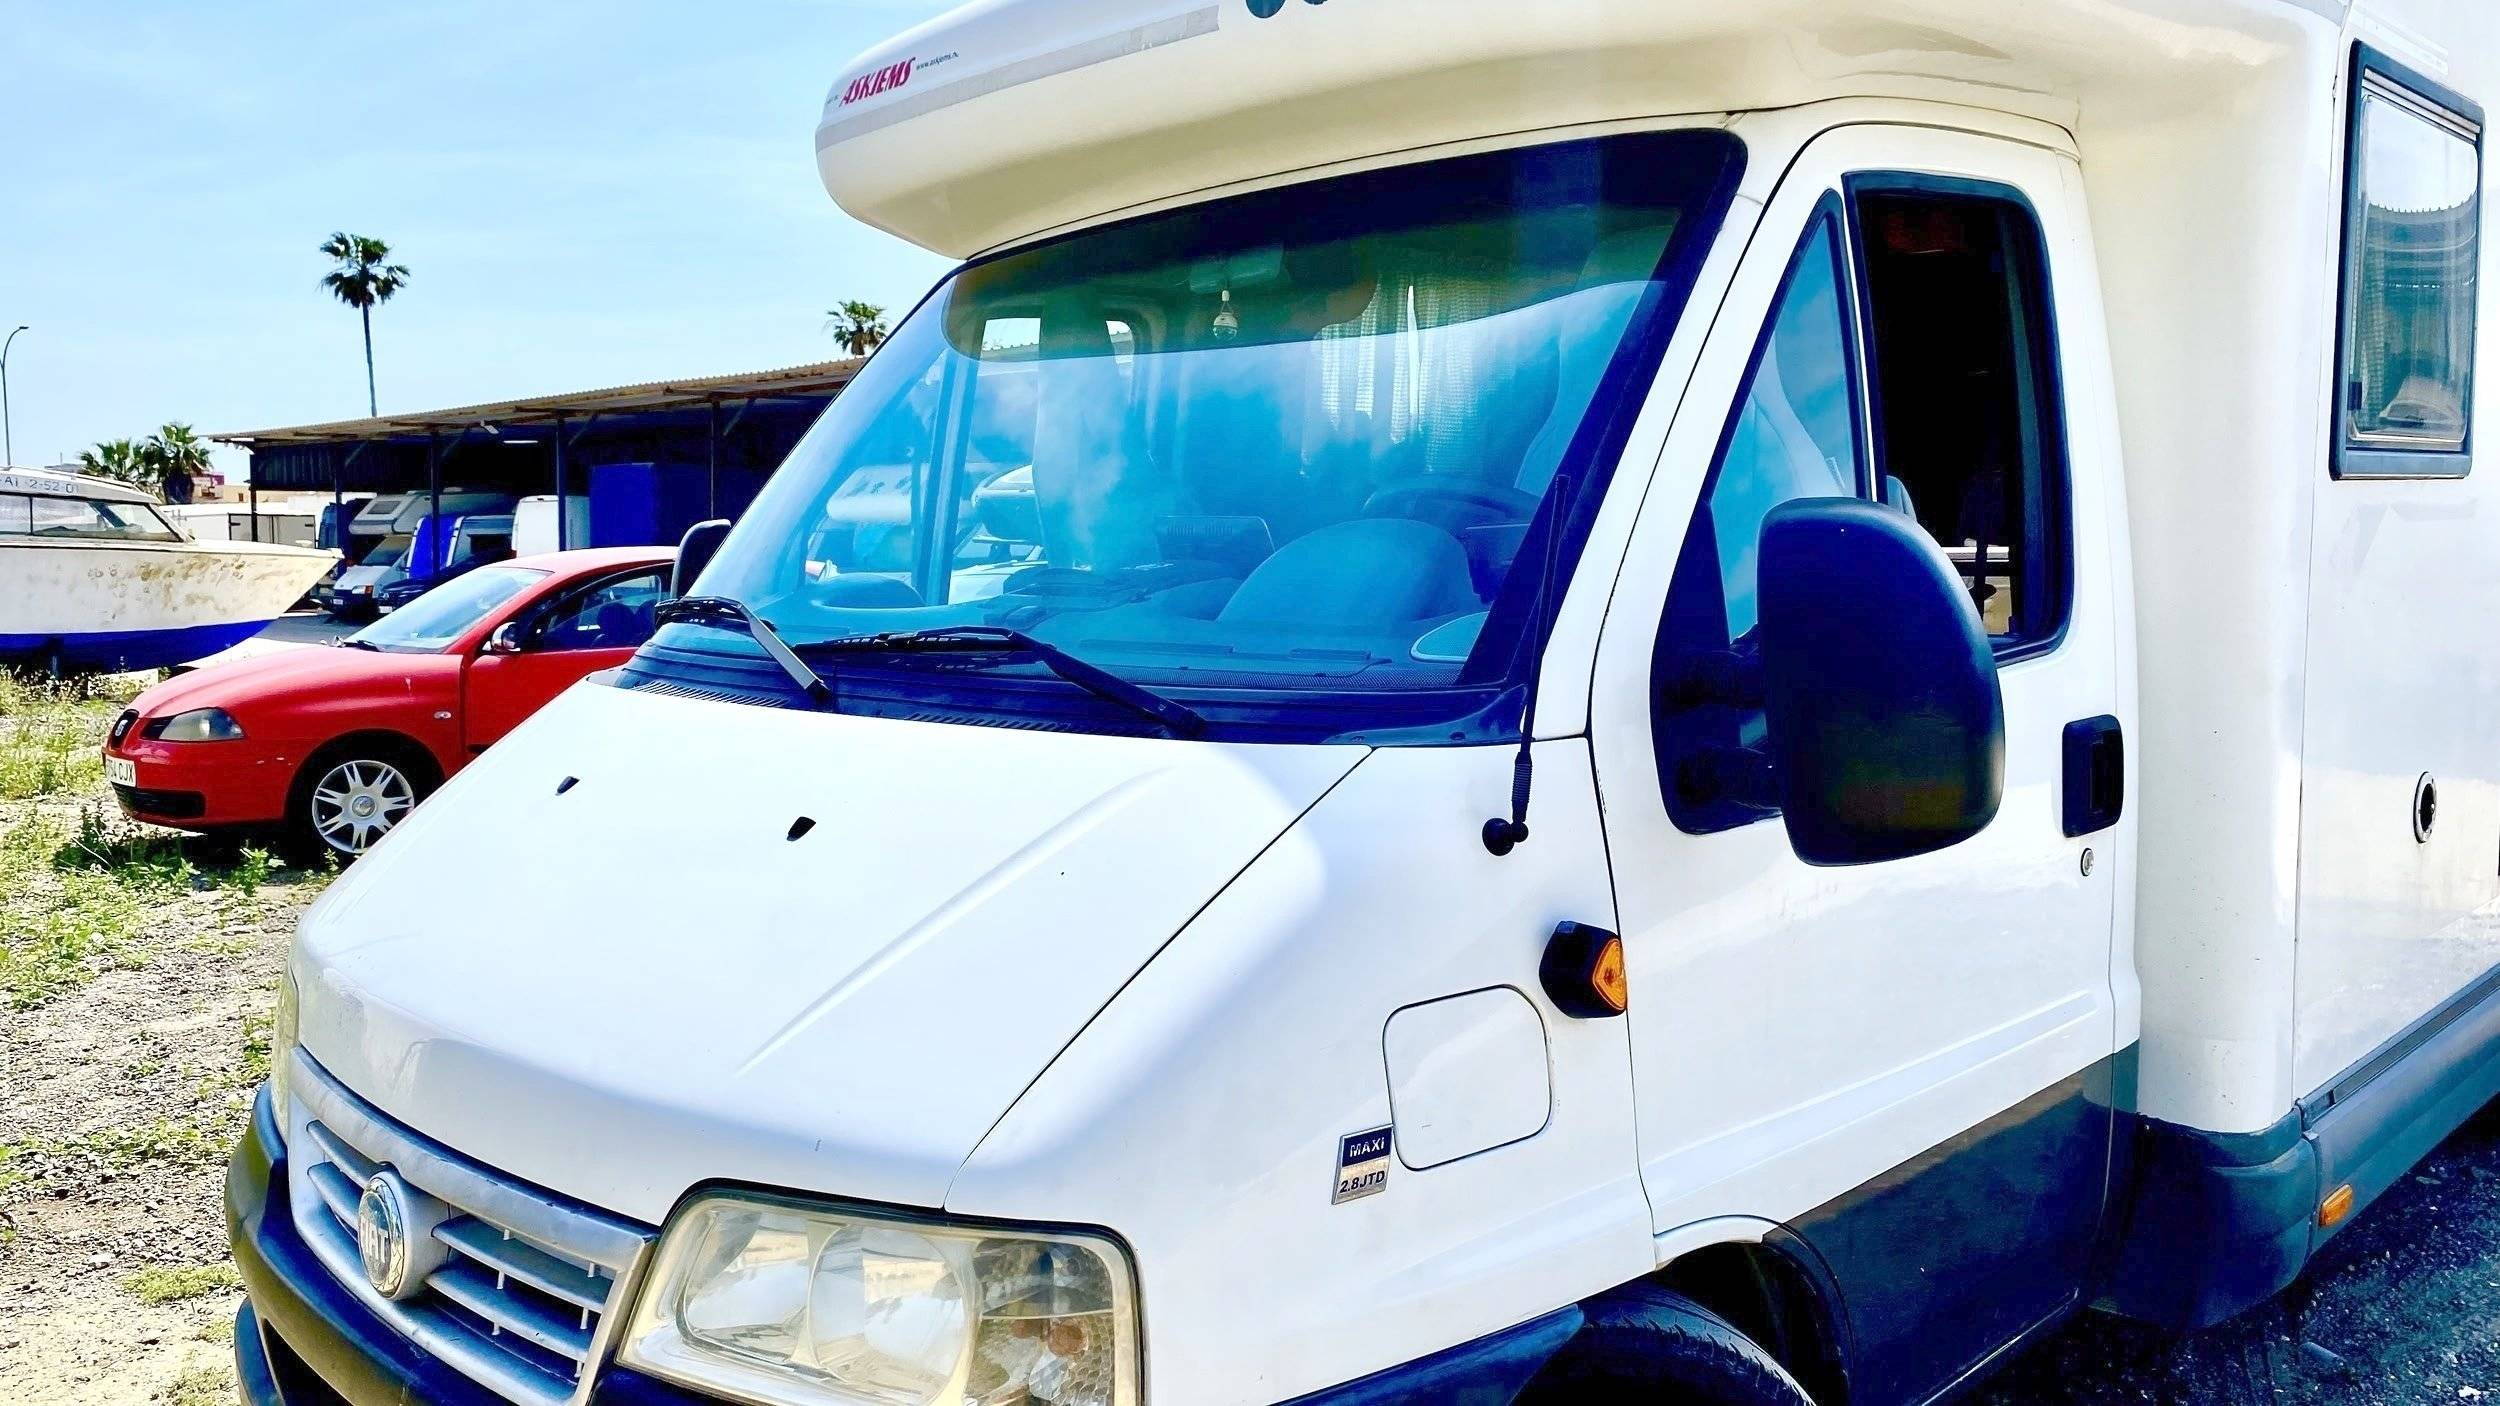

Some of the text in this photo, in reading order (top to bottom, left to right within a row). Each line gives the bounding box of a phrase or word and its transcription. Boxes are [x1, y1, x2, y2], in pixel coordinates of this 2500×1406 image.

[839, 57, 916, 107] ASKJEMS
[1349, 1137, 1385, 1157] MAXI
[360, 1213, 389, 1264] FIAT
